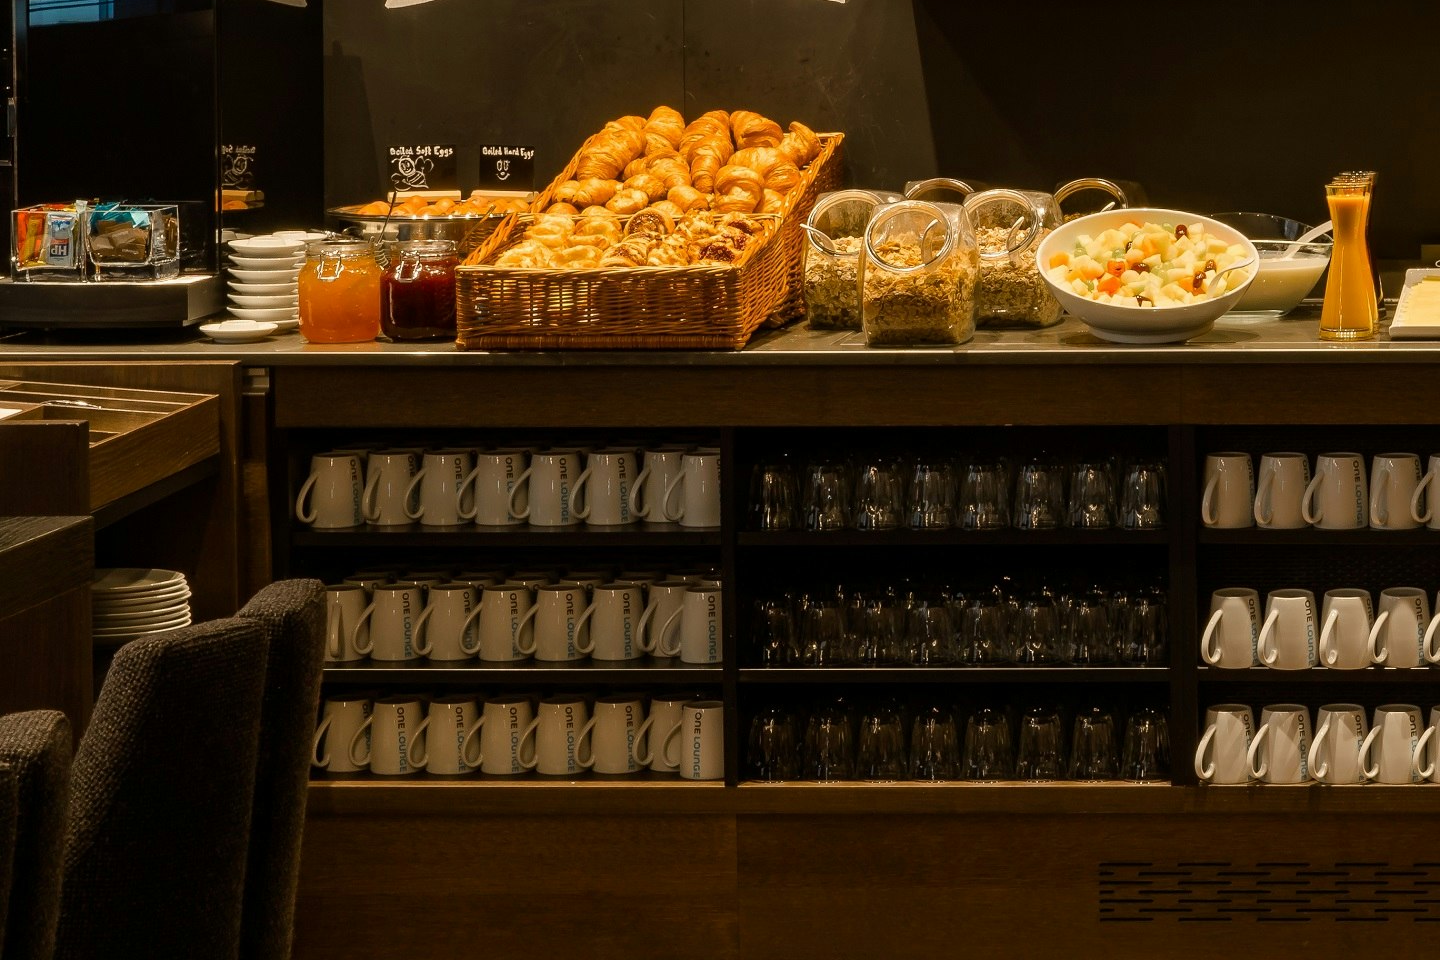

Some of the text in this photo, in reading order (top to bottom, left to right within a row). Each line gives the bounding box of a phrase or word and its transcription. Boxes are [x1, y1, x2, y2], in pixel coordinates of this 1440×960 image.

[416, 146, 432, 156] Soft
[434, 146, 453, 157] Eggs
[520, 148, 534, 159] Eggs
[51, 244, 68, 256] HP
[559, 457, 568, 480] ONE
[618, 457, 627, 479] ONE
[622, 592, 631, 615] ONE
[708, 595, 716, 618] ONE
[1304, 599, 1313, 623] ONE
[396, 707, 406, 729] ONE
[693, 712, 702, 734] ONE
